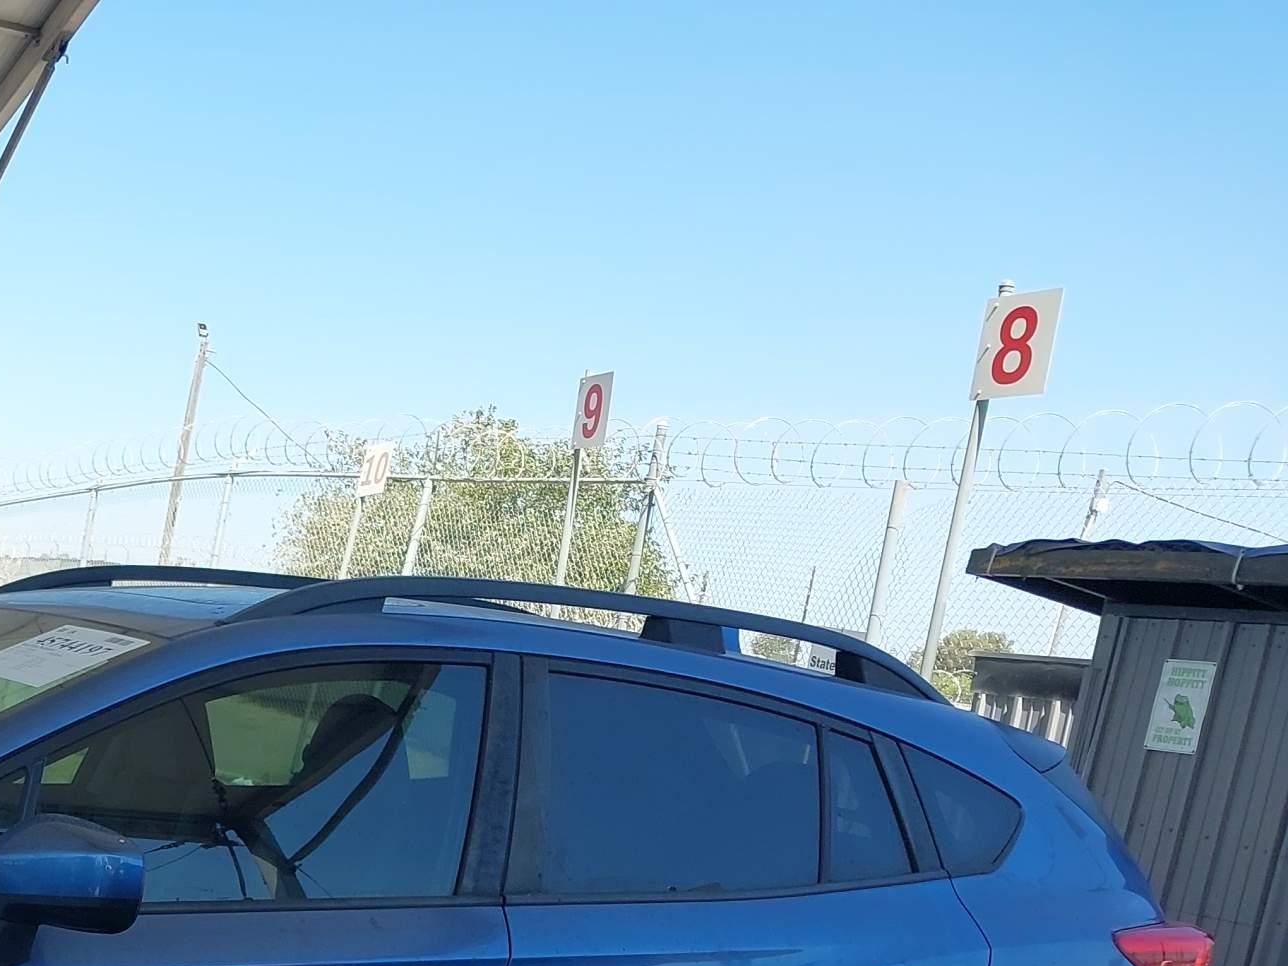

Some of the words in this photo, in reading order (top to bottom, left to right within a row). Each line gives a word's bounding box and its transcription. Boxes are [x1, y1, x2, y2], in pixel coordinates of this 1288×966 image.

[990, 305, 1039, 386] 8
[581, 382, 604, 439] 9
[360, 451, 390, 486] 10
[809, 655, 836, 671] State
